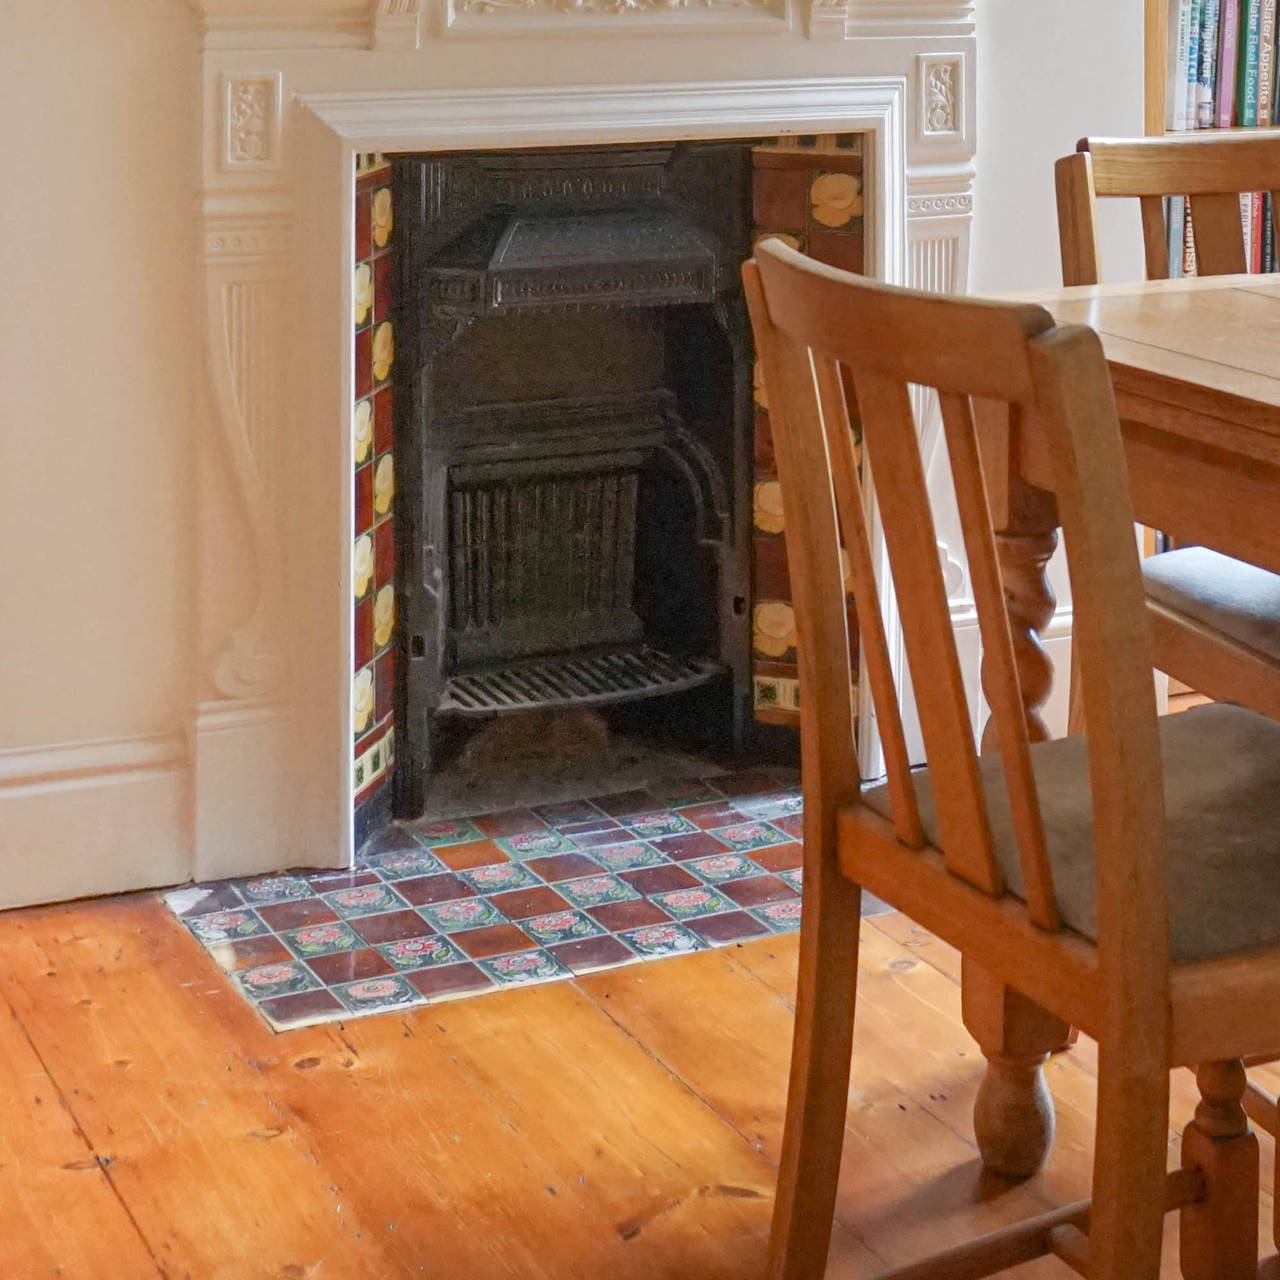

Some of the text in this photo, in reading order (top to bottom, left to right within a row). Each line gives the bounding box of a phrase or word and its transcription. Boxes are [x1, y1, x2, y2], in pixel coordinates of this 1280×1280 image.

[1248, 34, 1259, 65] Real
[1247, 69, 1258, 104] Food
[1259, 41, 1271, 104] Appetite
